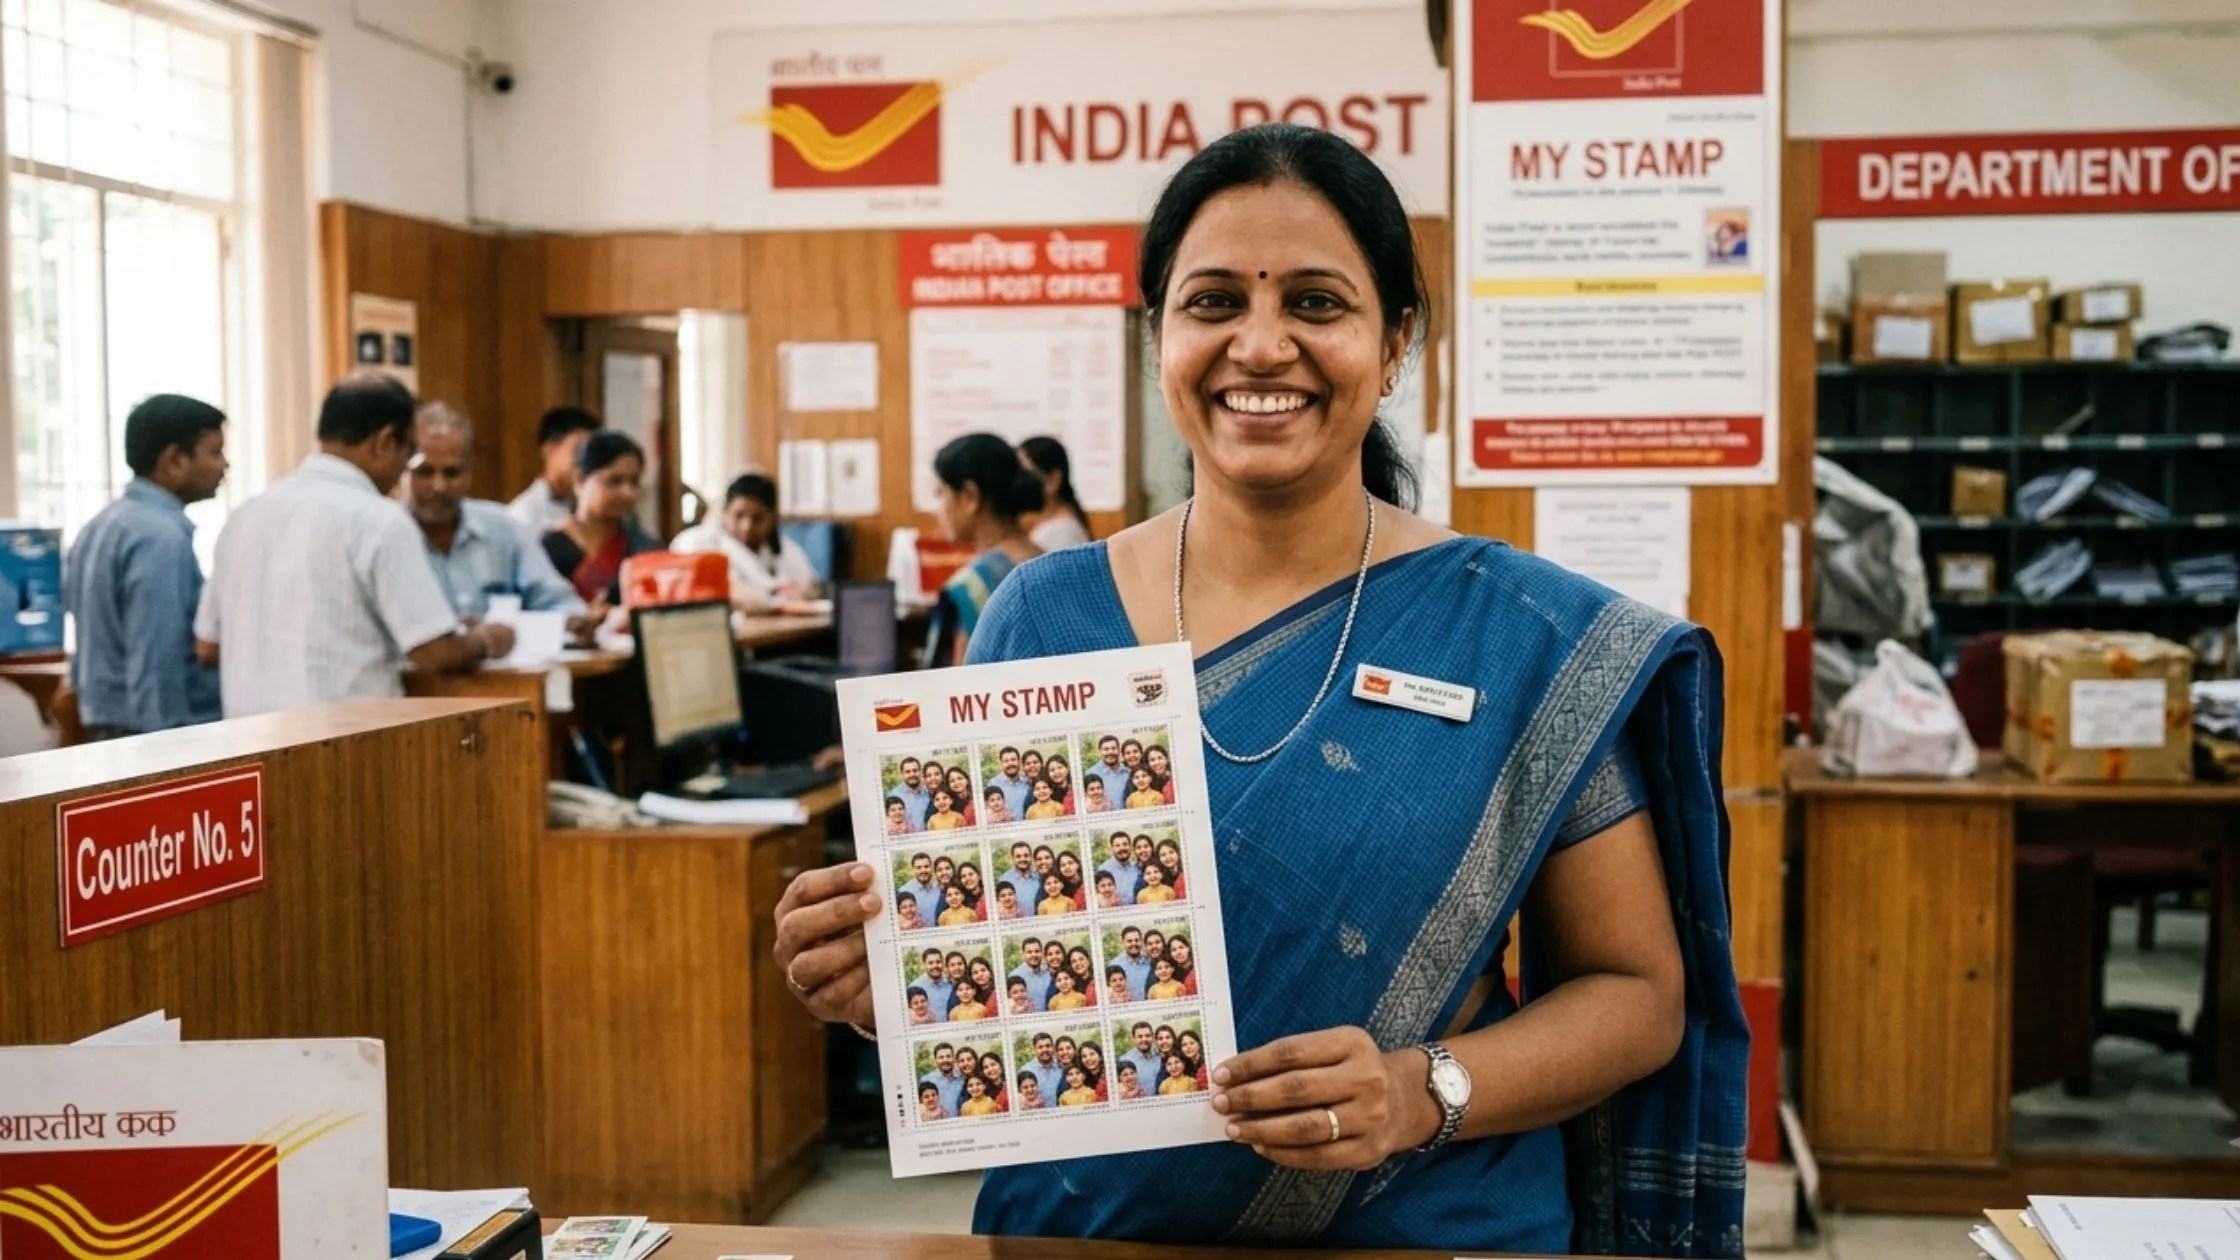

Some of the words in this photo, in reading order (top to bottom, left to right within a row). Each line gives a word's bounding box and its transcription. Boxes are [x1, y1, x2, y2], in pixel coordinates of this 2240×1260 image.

[1012, 101, 1200, 164] INDIA
[1510, 143, 1569, 180] MY
[1584, 137, 1724, 180] STAMP
[1858, 148, 2171, 200] DEPARTMENT
[2182, 145, 2240, 194] OF
[949, 694, 991, 724] MY
[1003, 682, 1097, 718] STAMP
[76, 824, 186, 901] Counter
[192, 809, 233, 870] No.
[240, 800, 255, 858] 5
[0, 1103, 107, 1141] भारतीय
